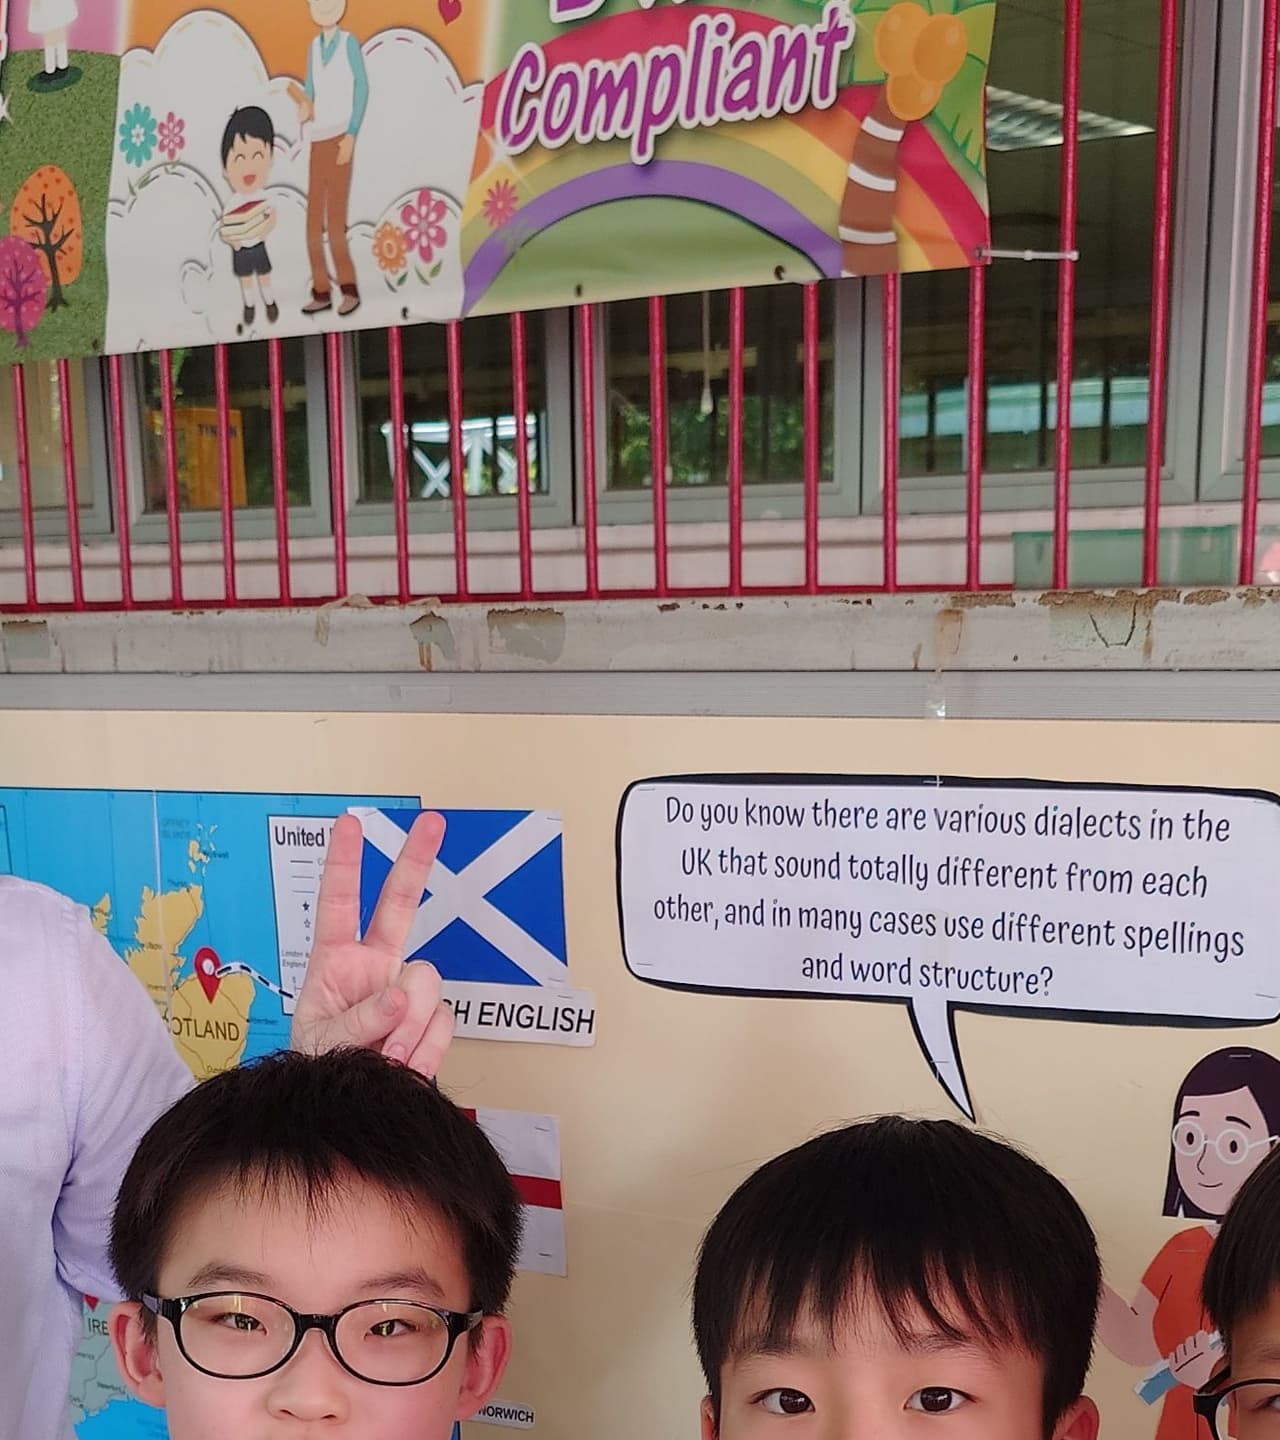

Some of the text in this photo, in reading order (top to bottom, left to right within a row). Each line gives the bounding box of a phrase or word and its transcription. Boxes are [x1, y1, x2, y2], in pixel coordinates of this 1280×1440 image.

[501, 10, 850, 157] Compliant
[274, 825, 325, 847] United
[666, 797, 1230, 842] Do you know there are various dialects in the
[681, 847, 1207, 898] UK that sound totally different from each
[654, 893, 1244, 963] other, and in many cases use different spellings
[802, 953, 1053, 996] and word structure?
[170, 1016, 240, 1041] OTLAND
[478, 1002, 595, 1034] ENGLISH
